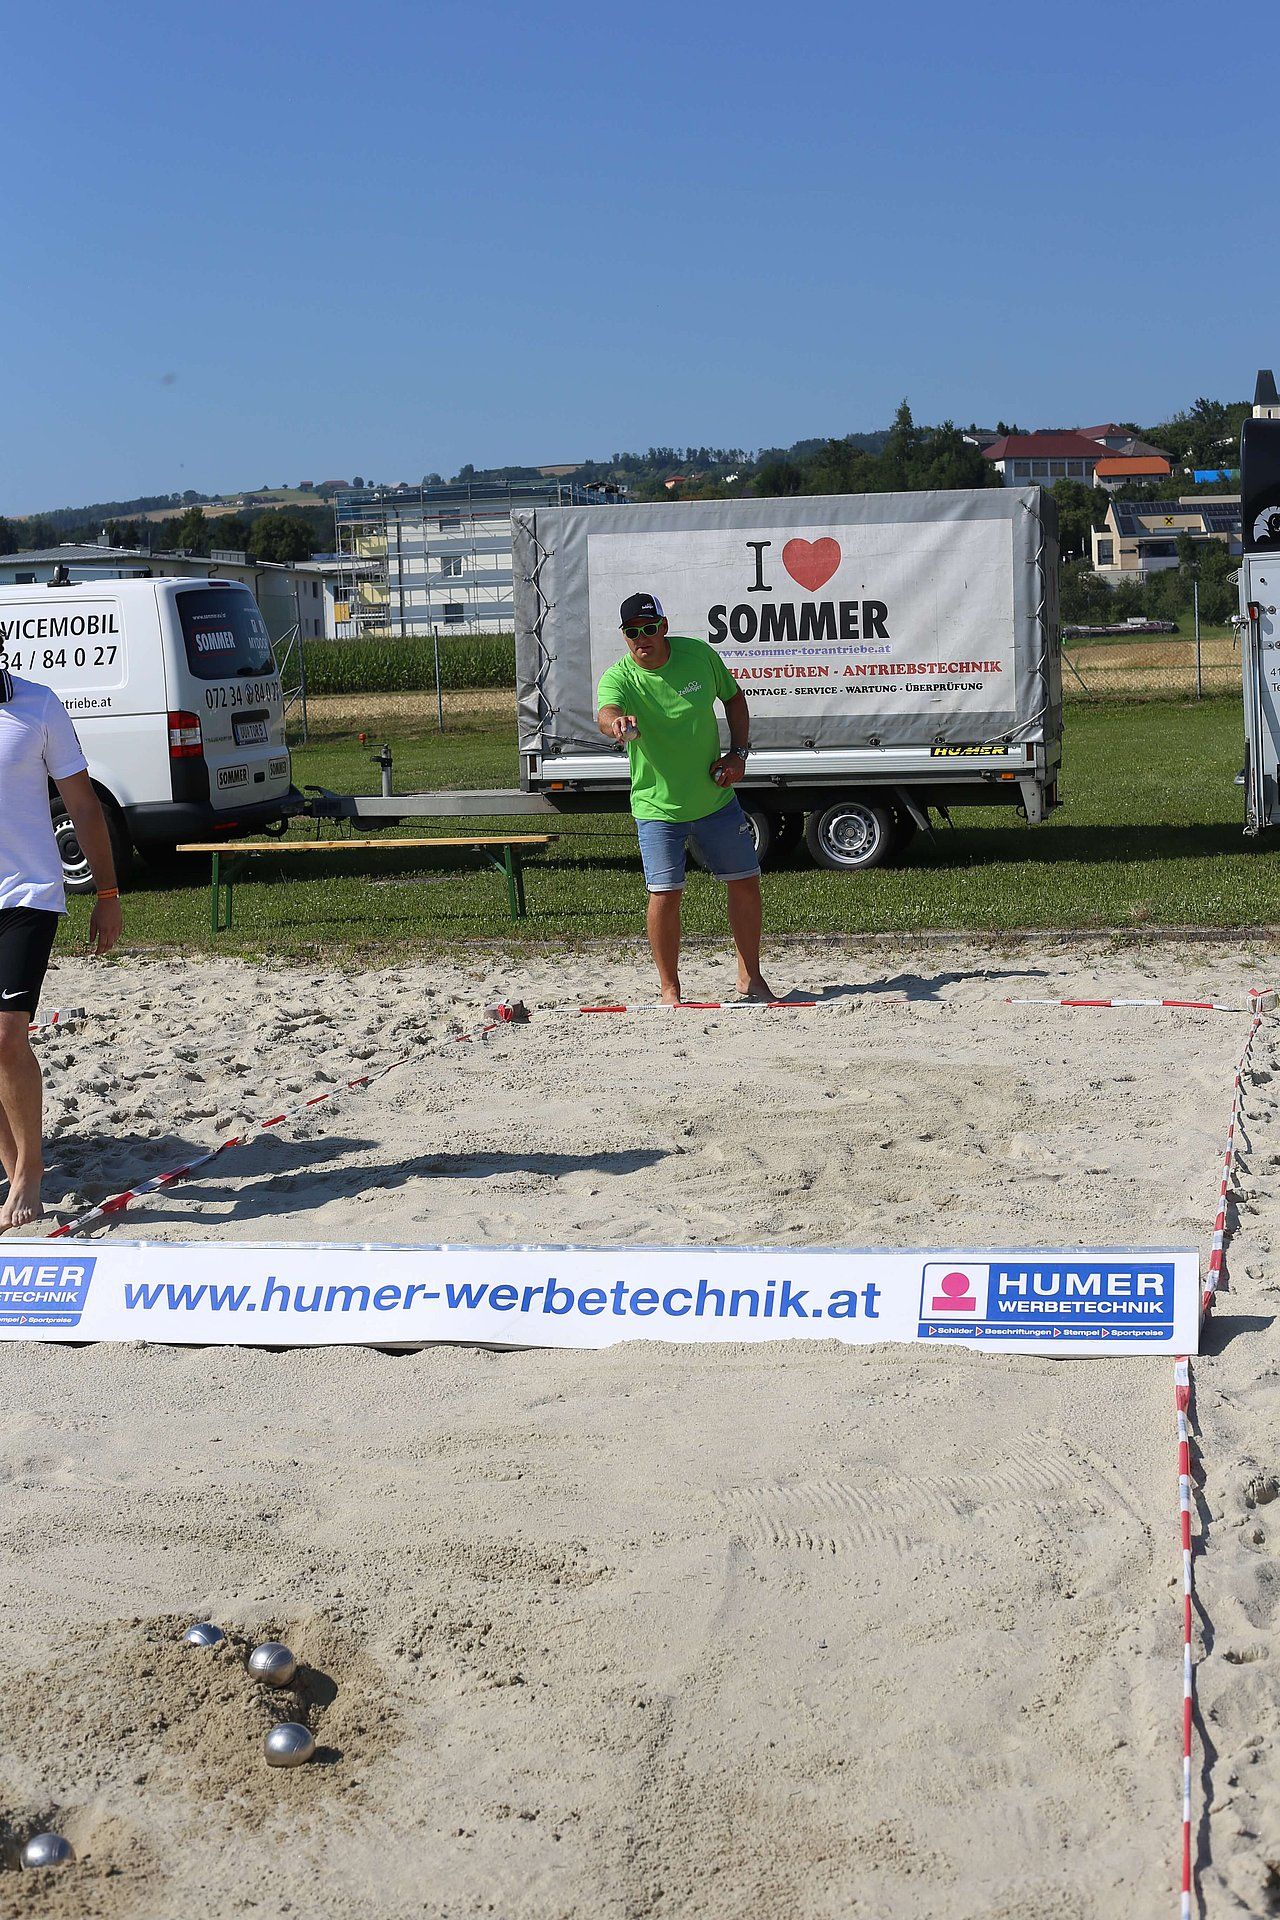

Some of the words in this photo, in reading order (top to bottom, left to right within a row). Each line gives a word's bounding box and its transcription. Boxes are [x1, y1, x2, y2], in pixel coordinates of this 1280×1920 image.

[746, 540, 772, 592] I
[0, 613, 119, 640] VICEMOBIL
[708, 600, 890, 644] SOMMER
[196, 631, 236, 652] SOMMER
[43, 648, 67, 669] 84
[74, 647, 86, 667] 0
[93, 645, 118, 666] 27
[728, 665, 829, 680] HAUSTÜREN
[842, 661, 1003, 677] ANTRIEBSTECHNIK
[205, 686, 228, 709] 072
[229, 684, 243, 706] 34
[743, 688, 787, 697] ONTAGE
[795, 686, 838, 695] SERVICE
[845, 684, 898, 694] WARTUNG
[905, 682, 983, 692] ÜBERPRÜFUNG
[62, 697, 112, 710] triebe.at
[933, 746, 1004, 756] HUMER
[219, 768, 247, 786] SOMMER
[0, 1265, 85, 1287] MER
[998, 1272, 1164, 1297] HUMER
[124, 1277, 881, 1318] www.humer-werbetechnik.at
[998, 1300, 1164, 1314] WERBETECHNIK
[28, 1315, 72, 1324] Sportpreise
[937, 1326, 974, 1335] Schilder
[985, 1328, 1052, 1337] Beschriftungen
[1063, 1328, 1100, 1337] Stempel
[1111, 1328, 1164, 1337] Sportpreise
